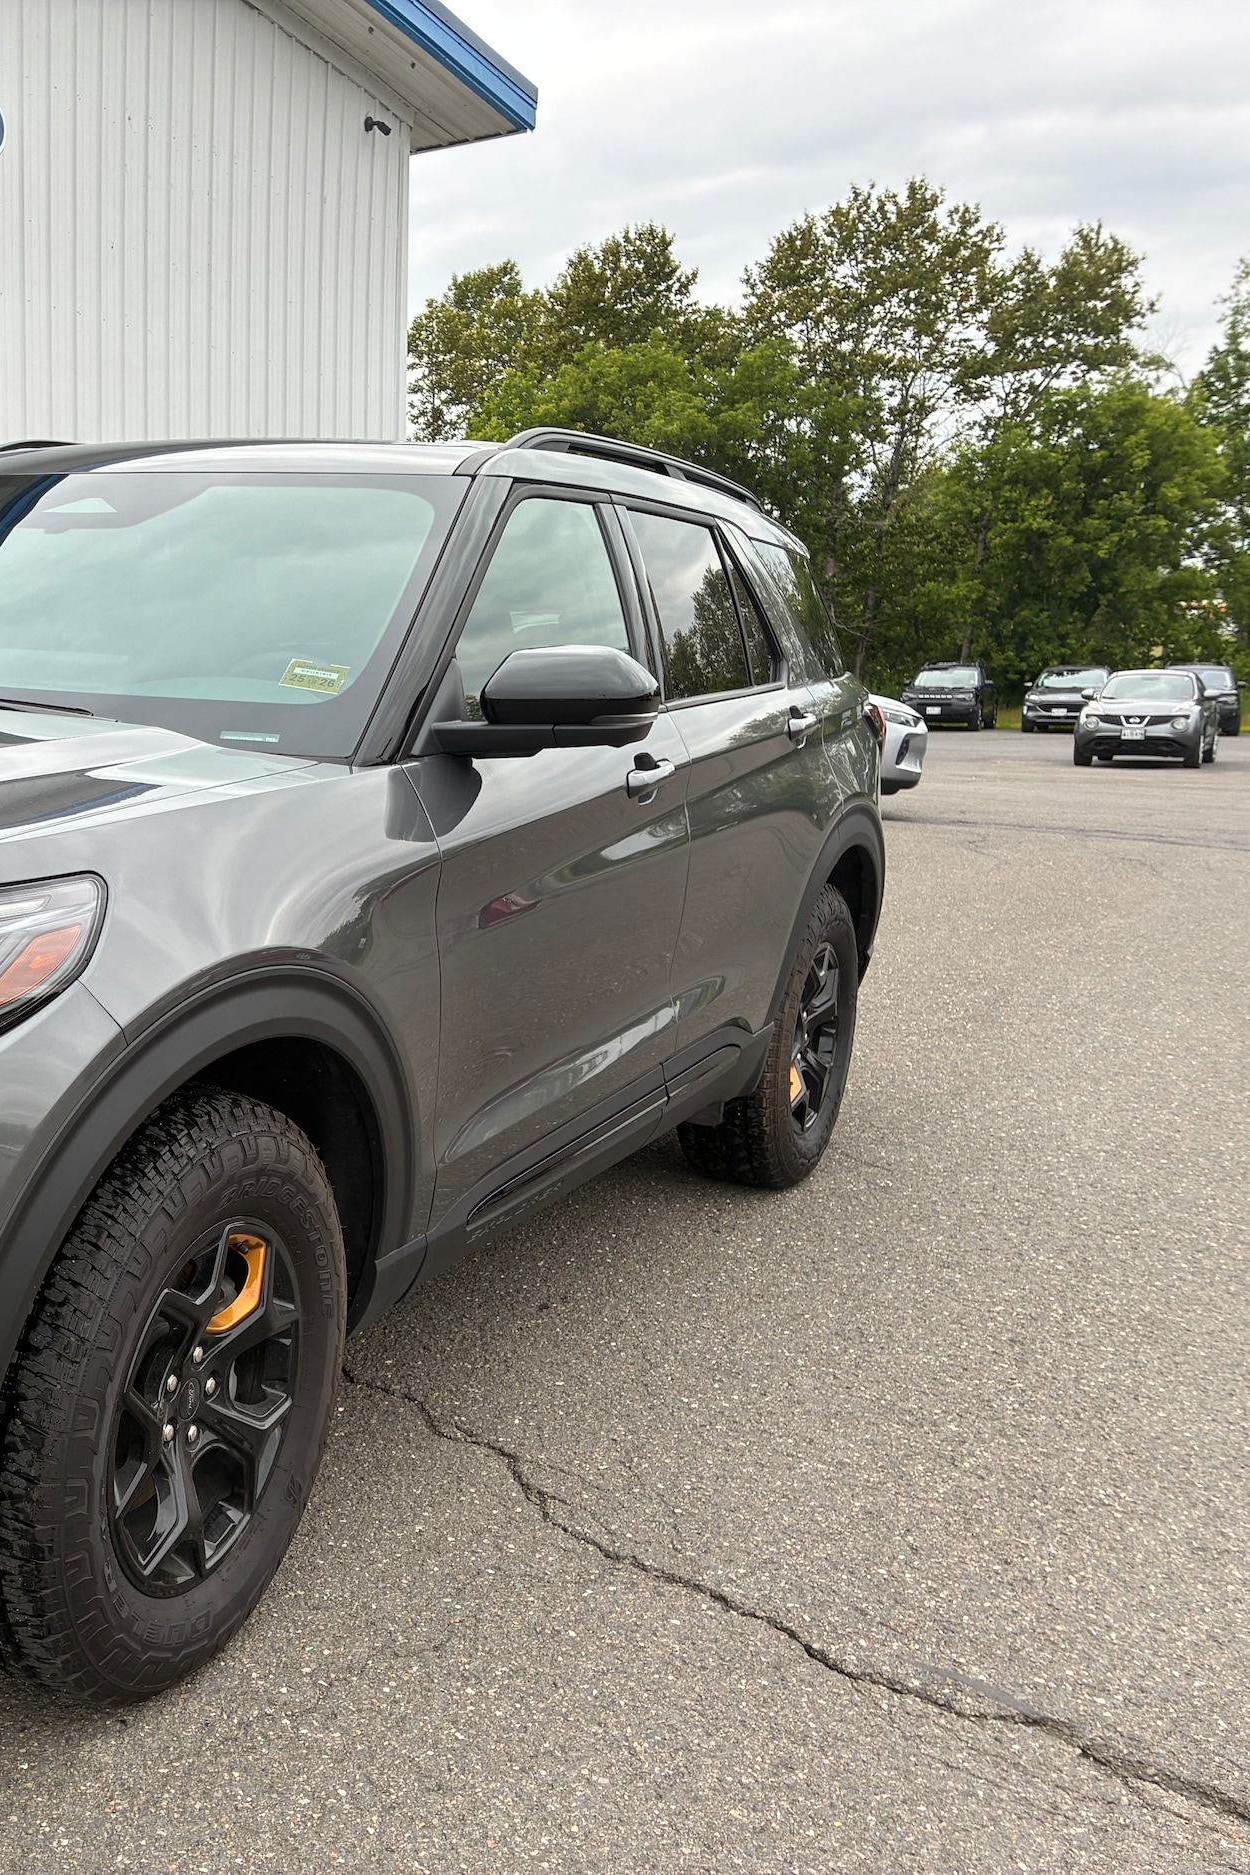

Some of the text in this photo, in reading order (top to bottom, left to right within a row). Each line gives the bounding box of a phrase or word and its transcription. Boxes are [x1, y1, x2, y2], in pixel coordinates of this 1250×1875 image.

[289, 674, 306, 683] 25
[318, 679, 336, 688] 26
[214, 1176, 334, 1318] BRIDGESTONE
